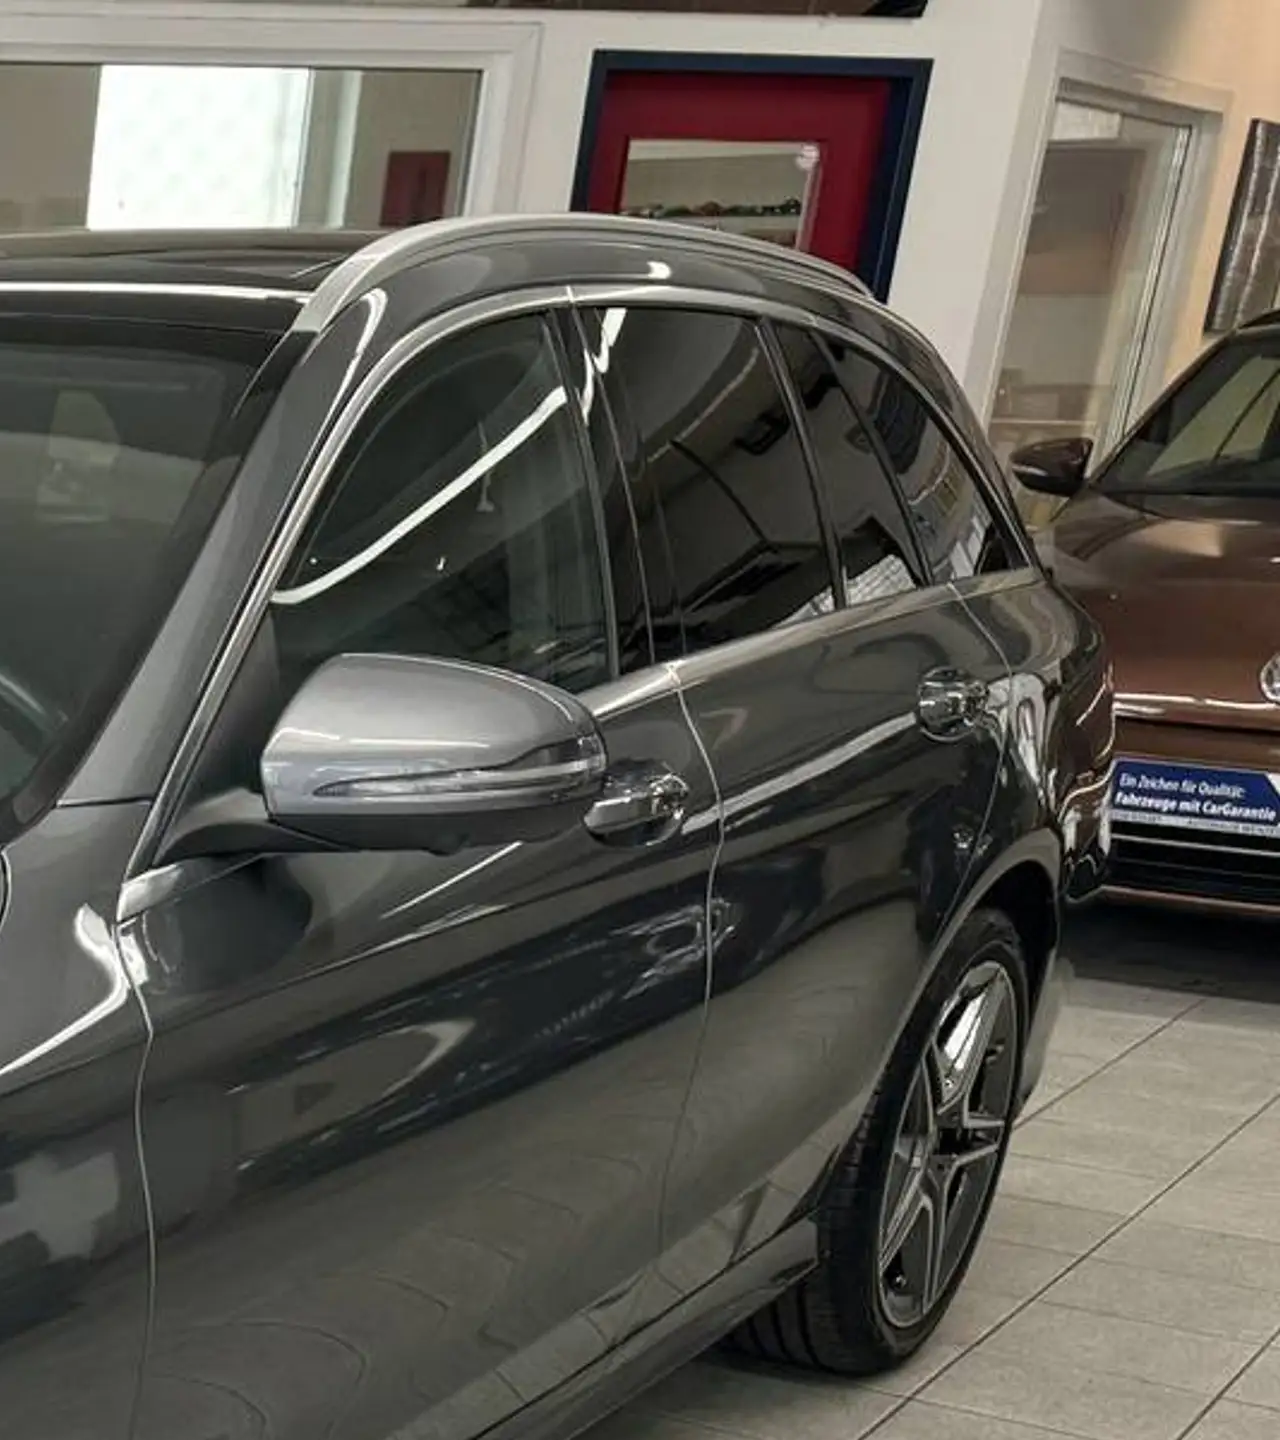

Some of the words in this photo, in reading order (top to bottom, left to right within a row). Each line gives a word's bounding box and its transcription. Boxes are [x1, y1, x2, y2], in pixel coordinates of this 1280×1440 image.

[1119, 772, 1137, 788] Ein
[1138, 774, 1178, 792] Zeichen
[1179, 779, 1197, 794] für
[1115, 791, 1177, 812] Fahrzeuge
[1179, 799, 1201, 813] mit
[1202, 799, 1277, 822] CarGarantie
